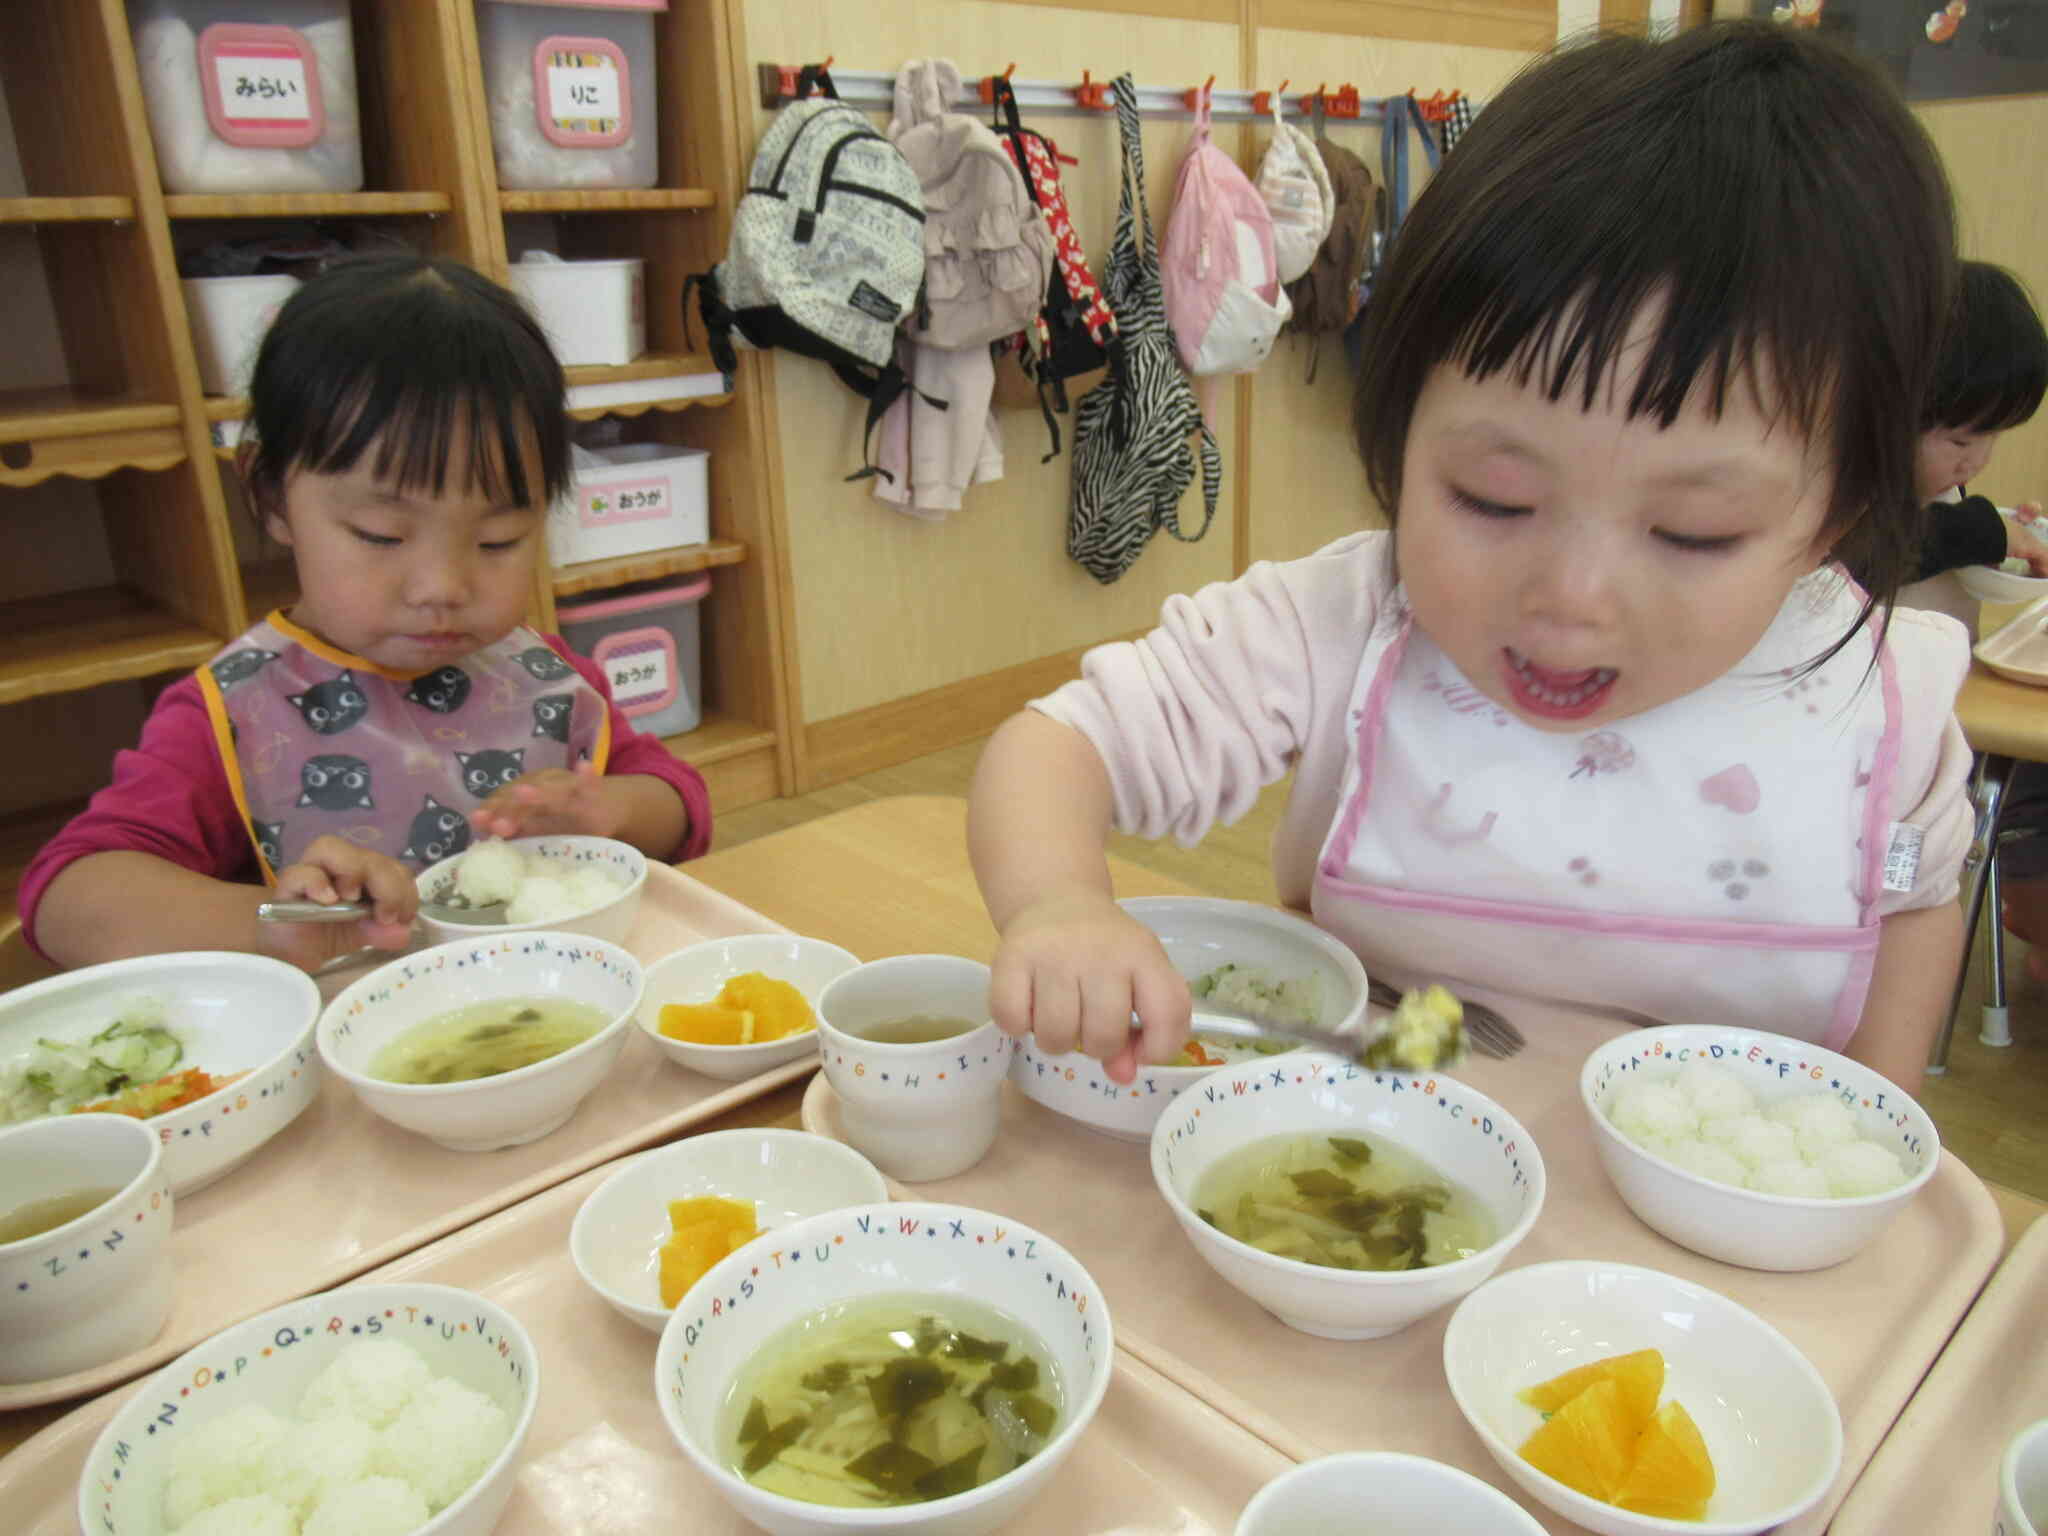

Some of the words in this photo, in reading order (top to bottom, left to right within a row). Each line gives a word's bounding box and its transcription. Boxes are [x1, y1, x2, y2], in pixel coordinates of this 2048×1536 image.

[236, 77, 297, 98] みらい
[570, 84, 600, 105] りこ
[903, 1072, 921, 1090] H
[956, 1054, 969, 1071] I
[1103, 1084, 1119, 1101] H
[1144, 1078, 1158, 1095] I
[1203, 1085, 1216, 1104] V
[1231, 1079, 1249, 1097] W
[1269, 1068, 1286, 1088] X
[1342, 1062, 1359, 1081] Z
[1391, 1076, 1405, 1093] A
[1422, 1078, 1437, 1095] B
[1450, 1103, 1464, 1118] C
[1482, 1116, 1494, 1135] D
[1653, 1040, 1665, 1057] B
[1678, 1047, 1691, 1063] C
[1709, 1044, 1725, 1059] D
[1746, 1045, 1763, 1063] E
[1778, 1062, 1791, 1080] F
[1809, 1065, 1825, 1081] G
[1875, 1093, 1886, 1110] I
[684, 1324, 700, 1347] Q
[711, 1297, 723, 1318] R
[739, 1278, 755, 1299] S
[770, 1249, 784, 1270] T
[814, 1243, 831, 1263] U
[856, 1213, 871, 1234] V
[899, 1216, 920, 1236] W
[949, 1218, 966, 1239] X
[1025, 1239, 1038, 1259] Z
[1056, 1279, 1067, 1300] A
[193, 1366, 212, 1389] O
[234, 1356, 249, 1377] P
[274, 1326, 301, 1348] Q
[326, 1316, 344, 1336] R
[366, 1315, 383, 1335] S
[405, 1306, 419, 1324] T
[441, 1322, 456, 1341] U
[475, 1315, 487, 1336] V
